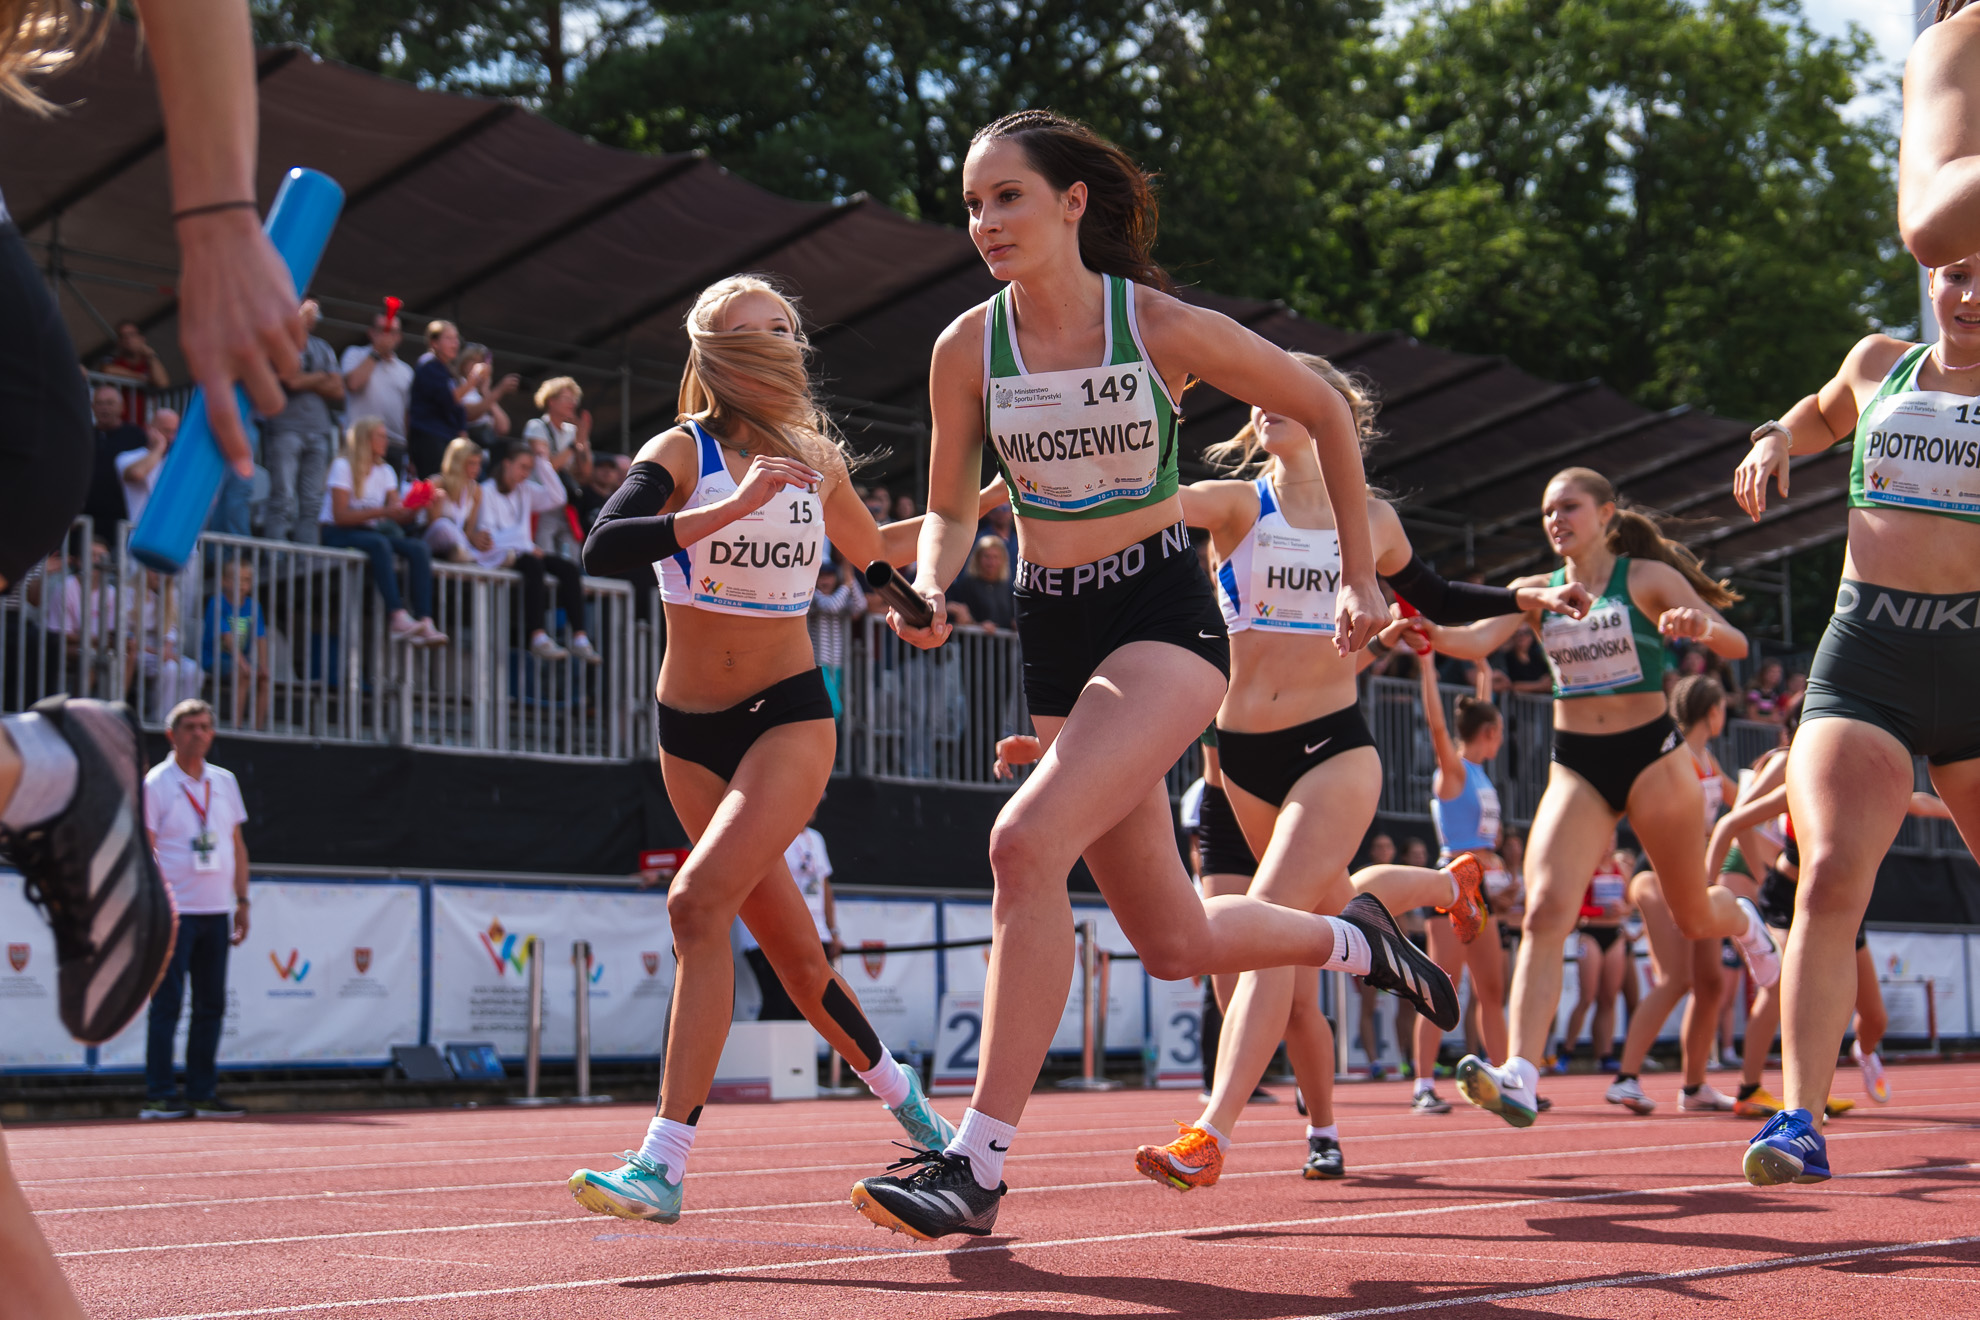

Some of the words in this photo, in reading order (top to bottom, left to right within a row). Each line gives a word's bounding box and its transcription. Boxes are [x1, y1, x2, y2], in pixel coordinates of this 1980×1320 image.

[1014, 387, 1049, 396] Ministerstwo
[1037, 393, 1062, 401] Turystyki
[1081, 373, 1138, 407] 149
[1955, 404, 1980, 425] 15
[998, 419, 1154, 463] MIŁOSZEWICZ
[1868, 430, 1980, 470] PIOTROWS
[789, 500, 813, 524] 15
[1037, 497, 1061, 508] POZNAŃ
[709, 534, 817, 569] DŻUGAJ
[1072, 542, 1145, 596] PRO
[1267, 565, 1341, 593] HURY
[713, 597, 743, 607] POZNAŃ
[1866, 592, 1980, 631] NIK
[1589, 612, 1623, 632] 318
[1550, 637, 1632, 665] SKOWROŃSKA
[947, 1011, 982, 1069] 2
[1170, 1011, 1203, 1065] 3
